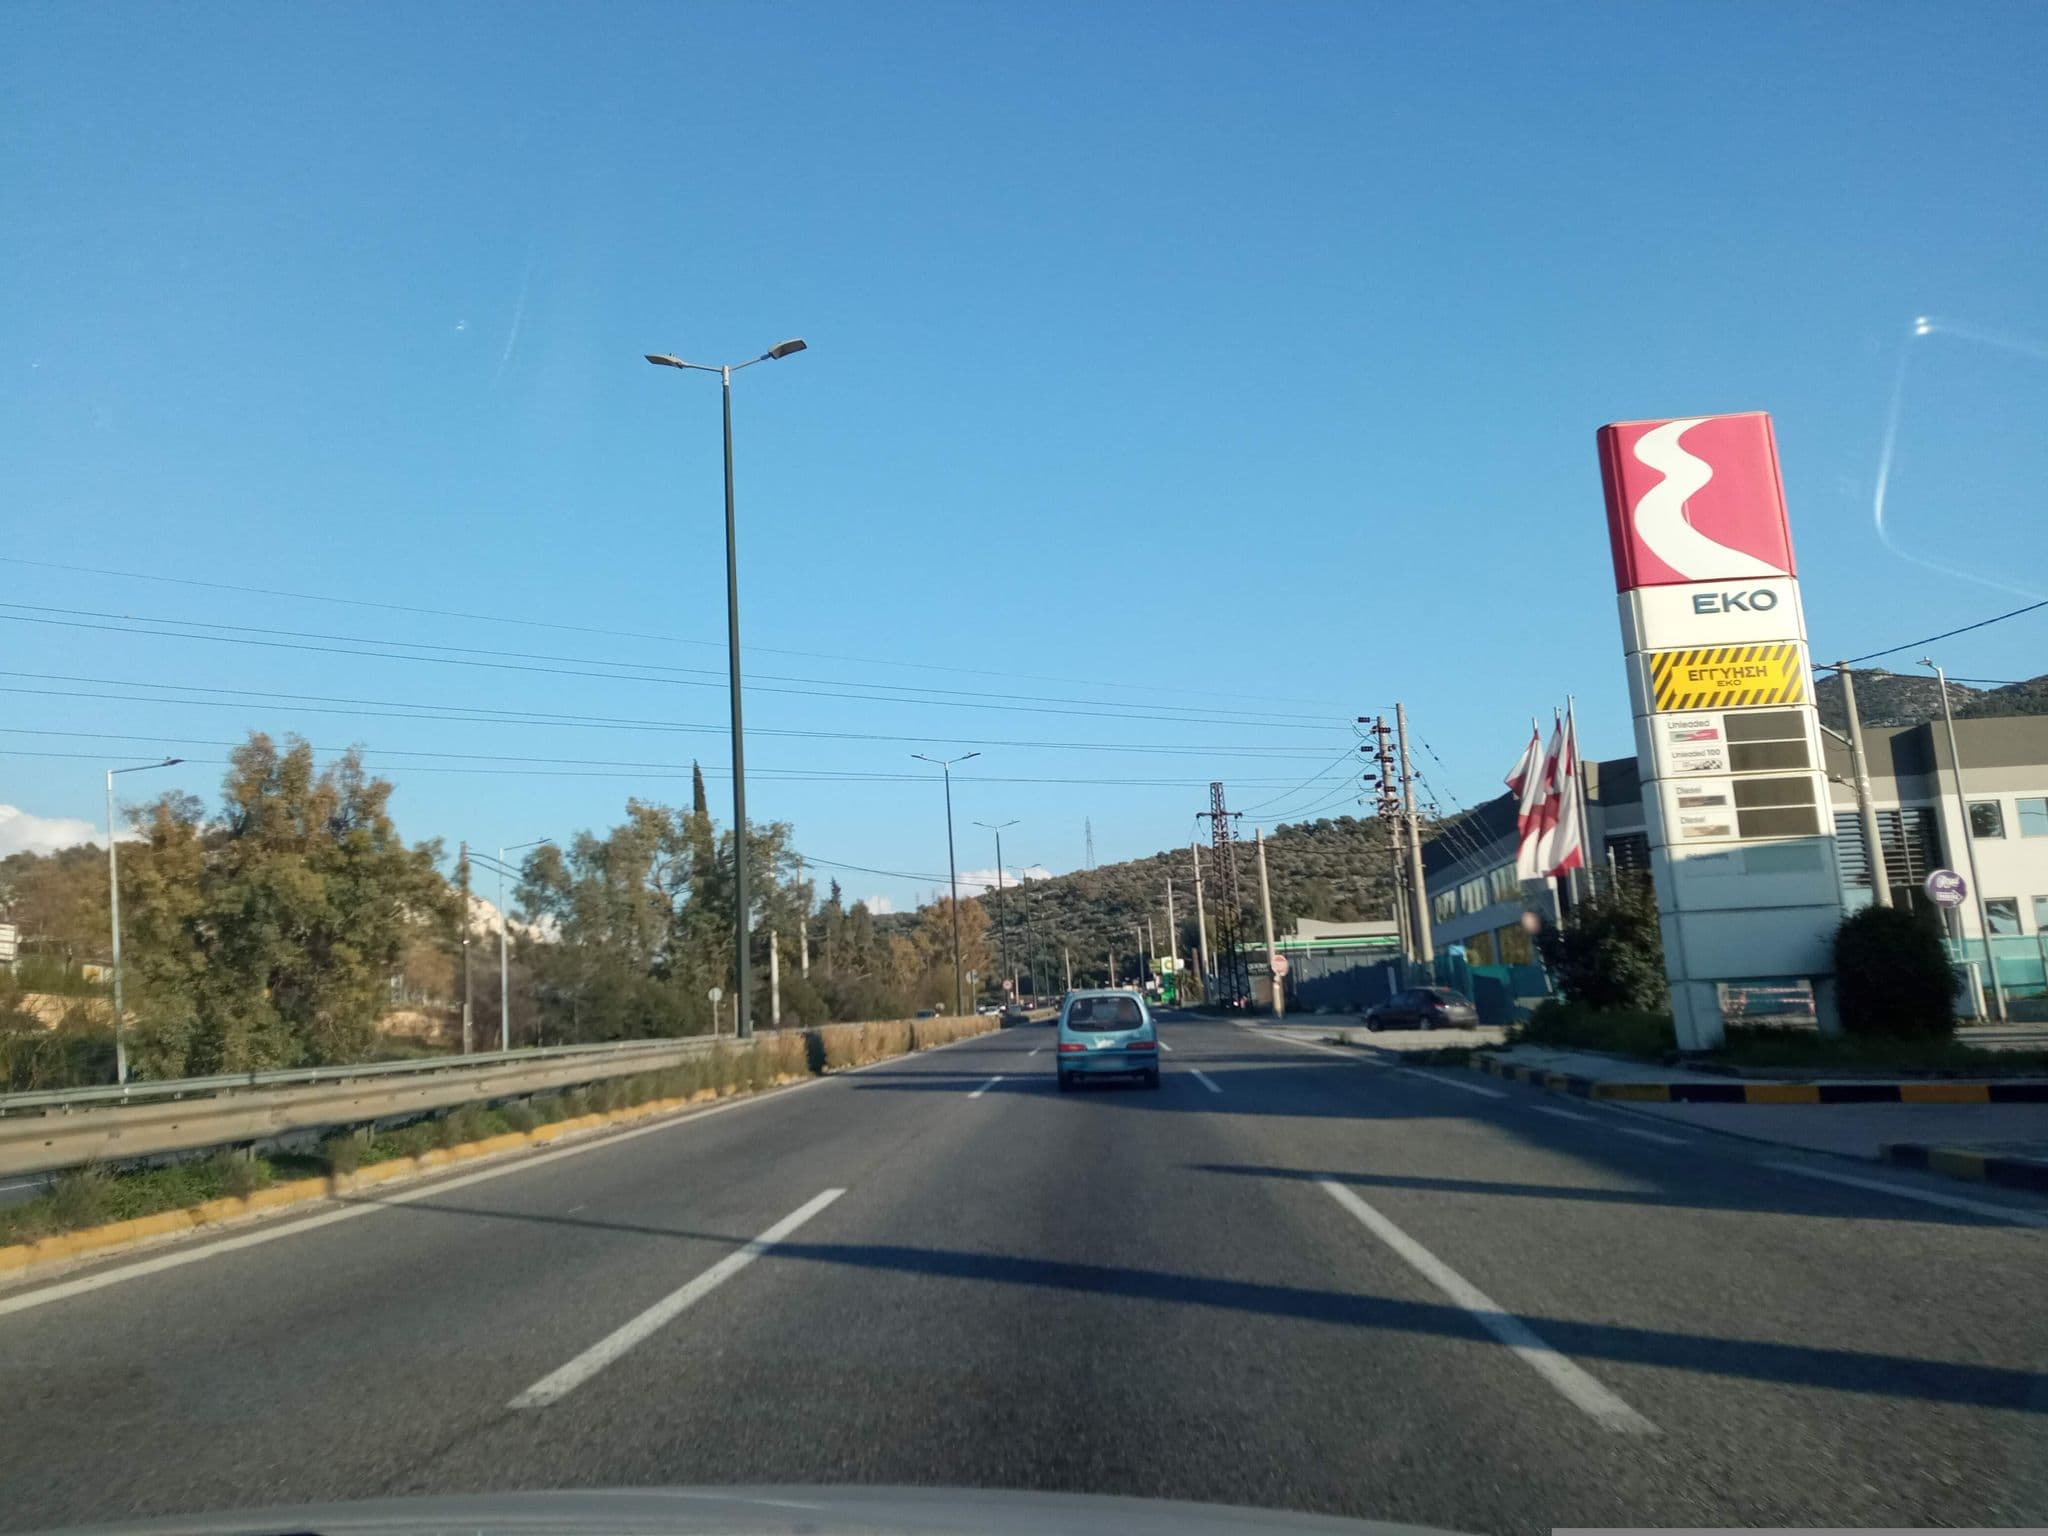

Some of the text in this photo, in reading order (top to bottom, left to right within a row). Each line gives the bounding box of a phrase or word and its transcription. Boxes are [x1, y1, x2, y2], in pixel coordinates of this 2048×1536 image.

[1692, 589, 1778, 615] EKO
[1688, 665, 1768, 682] ΕΓΓΥΗΣΗ
[1717, 679, 1742, 687] EKO
[1667, 720, 1710, 729] Unleaded
